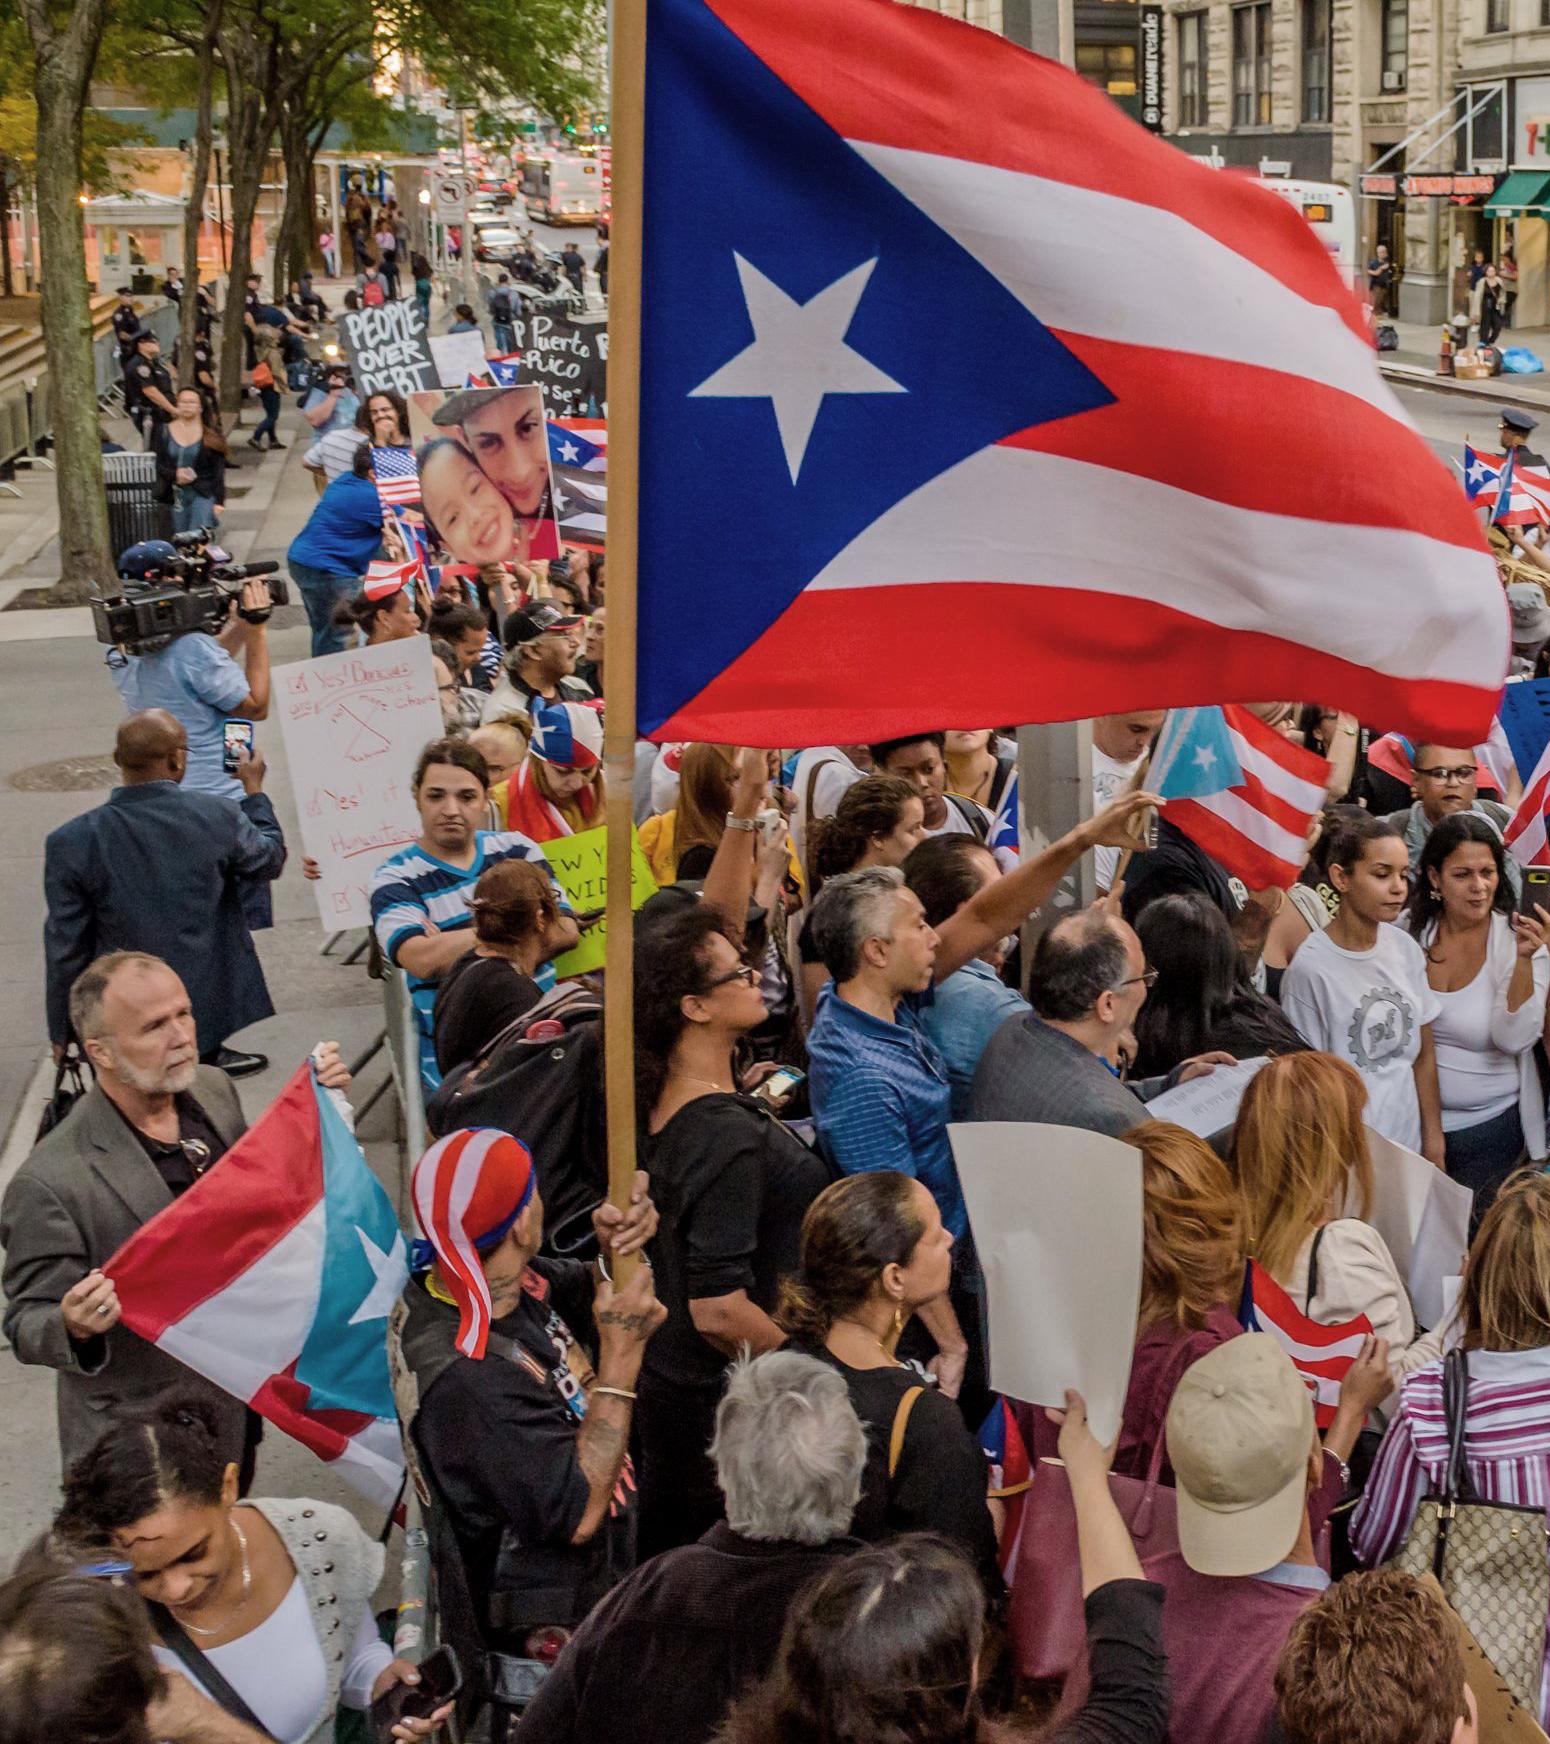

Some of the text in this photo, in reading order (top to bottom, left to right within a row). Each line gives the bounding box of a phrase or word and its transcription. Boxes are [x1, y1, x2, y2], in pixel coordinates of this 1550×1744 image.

[345, 296, 425, 349] PEOPLE
[531, 316, 590, 358] Puerto
[358, 340, 426, 372] OVER
[359, 361, 432, 399] DEBT
